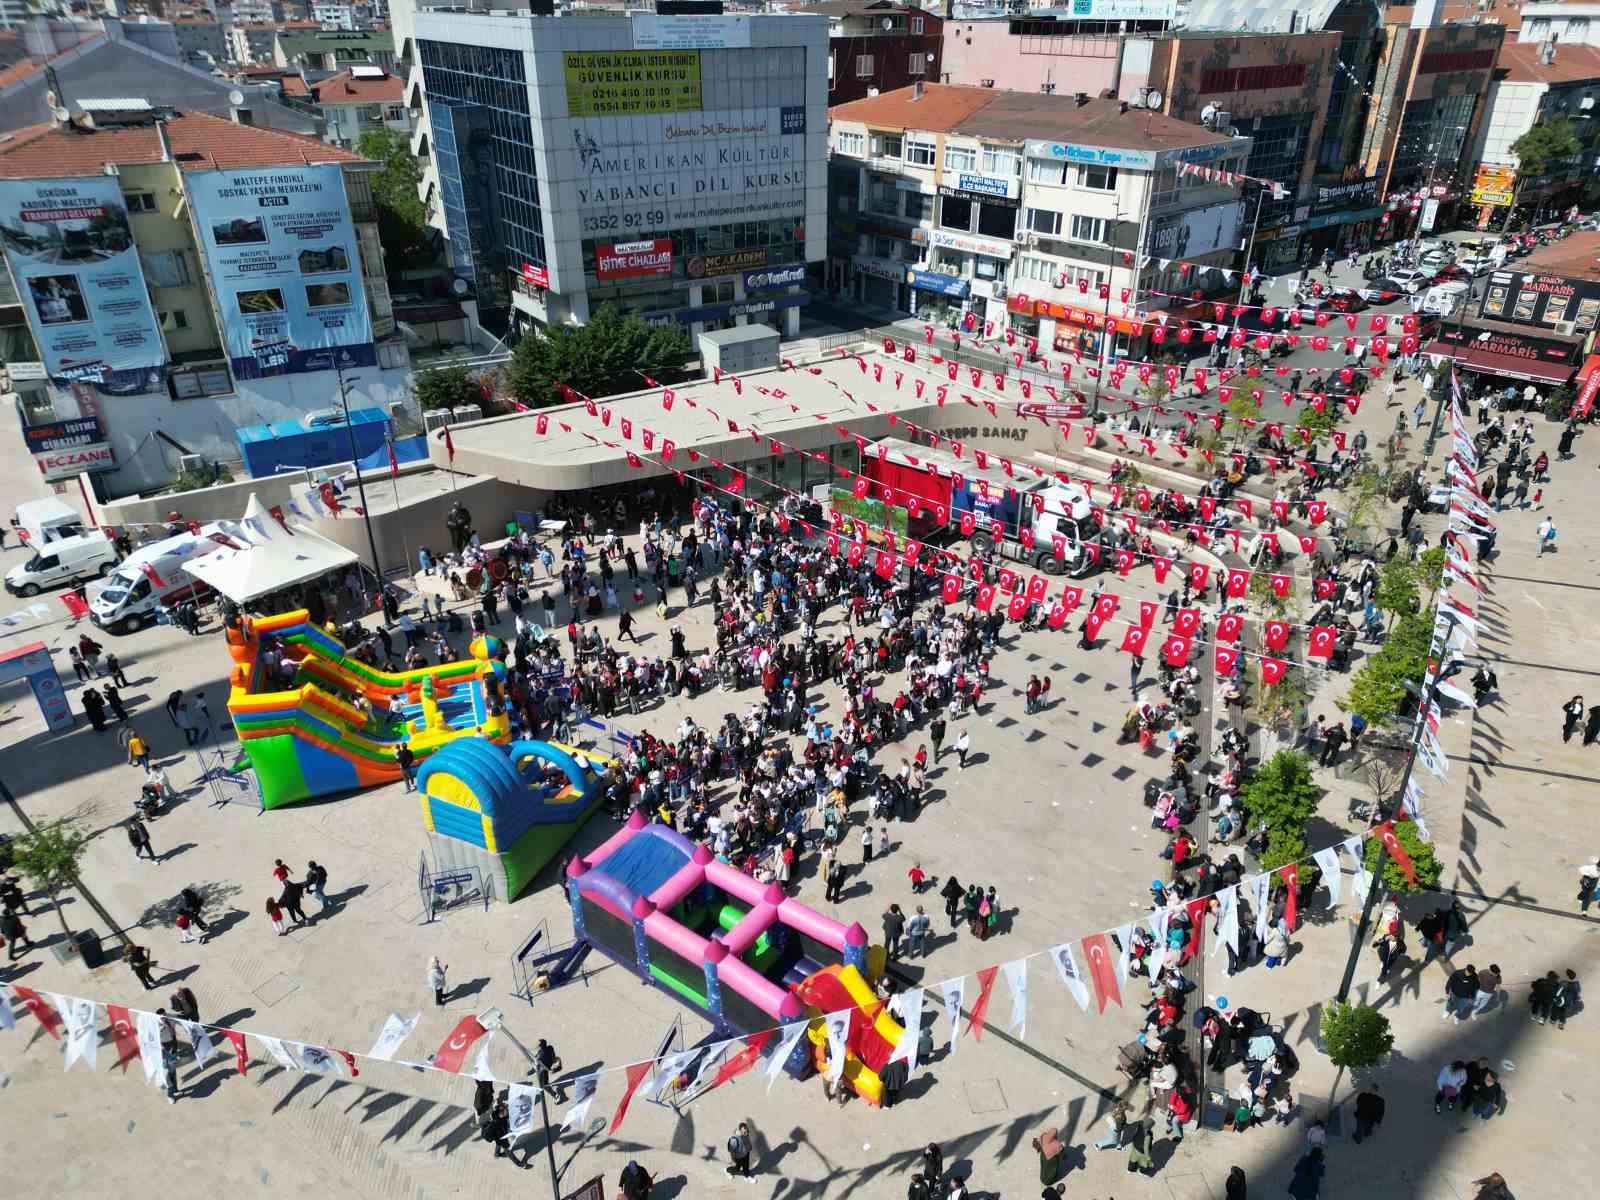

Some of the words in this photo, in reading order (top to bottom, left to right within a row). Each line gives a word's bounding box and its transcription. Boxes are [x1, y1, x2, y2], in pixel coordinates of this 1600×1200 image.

[233, 175, 270, 186] MALTEPE
[578, 181, 678, 204] YABANCI
[745, 170, 804, 189] KURSU
[1468, 339, 1538, 360] MARMARİS
[46, 447, 110, 468] ECZANE
